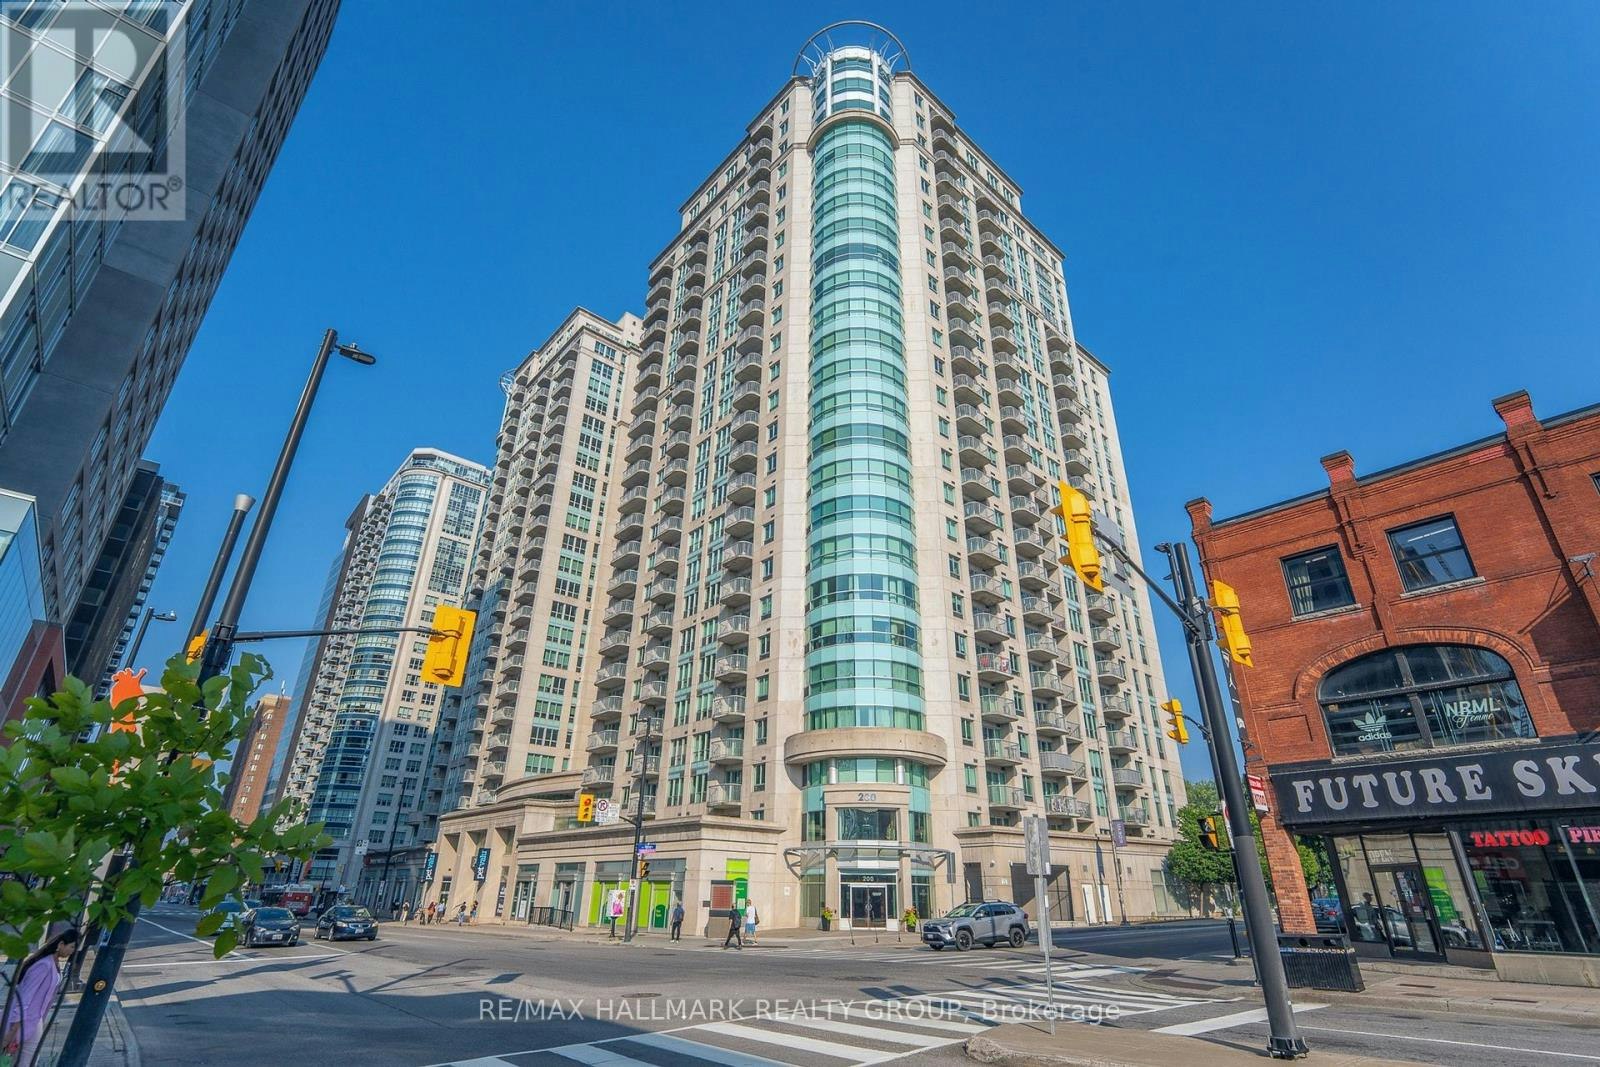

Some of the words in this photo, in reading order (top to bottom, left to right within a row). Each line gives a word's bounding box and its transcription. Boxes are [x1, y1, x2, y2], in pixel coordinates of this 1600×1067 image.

[1445, 697, 1501, 717] NRML
[1358, 731, 1392, 742] adidas
[1292, 764, 1492, 813] FUTURE
[1512, 753, 1600, 798] SK
[1470, 829, 1551, 848] TATTOO
